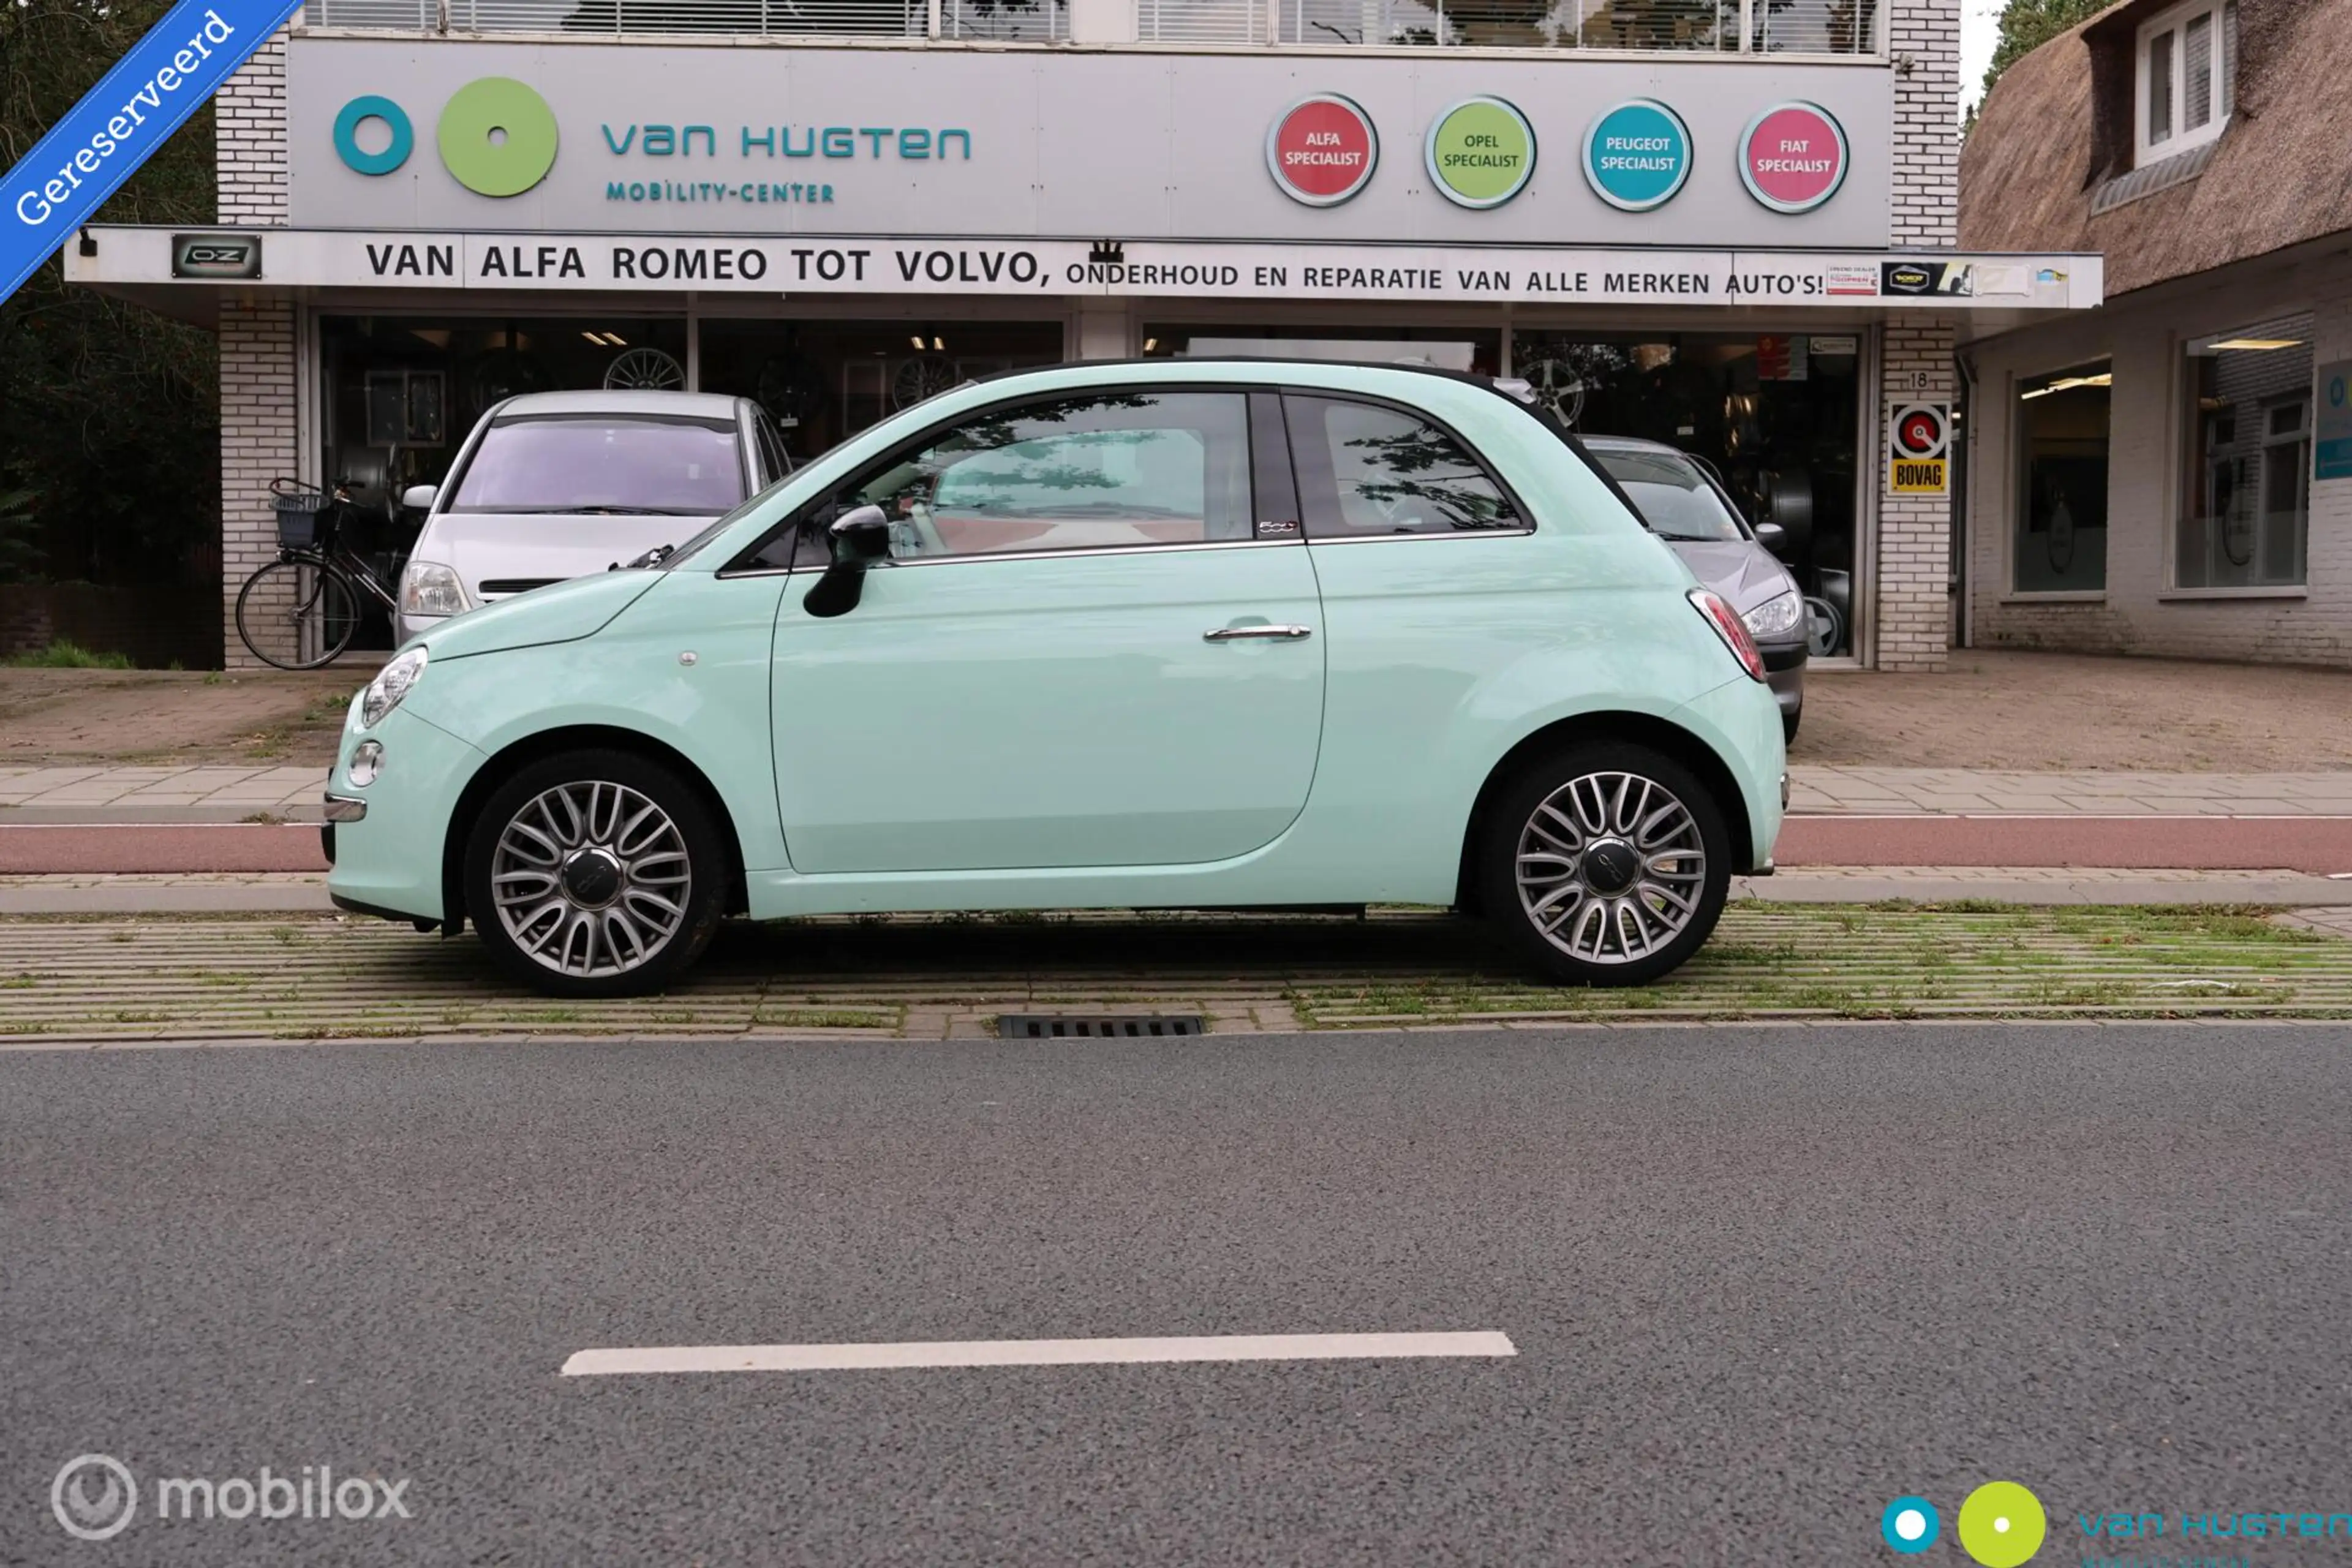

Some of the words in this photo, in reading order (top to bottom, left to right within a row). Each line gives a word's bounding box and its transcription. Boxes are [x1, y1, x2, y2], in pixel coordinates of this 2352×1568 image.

[1306, 133, 1341, 146] ALFA
[1464, 135, 1499, 148] OPEL
[1607, 137, 1670, 151] PEUGEOT
[1780, 140, 1809, 153] FIAT
[1286, 151, 1362, 166] SPECIALIST
[1444, 154, 1518, 168] SPECIALIST
[1600, 156, 1676, 171] SPECIALIST
[1757, 159, 1831, 173] SPECIALIST
[606, 181, 838, 203] MOBILITY-CENTER
[366, 244, 453, 276] VAN
[481, 246, 586, 278] ALFA
[614, 247, 767, 281] ROMEO
[791, 249, 871, 281] TOT
[895, 251, 1050, 287] VOLVO,
[1066, 263, 1238, 285] ONDERHOUD
[1256, 266, 1286, 287] EN
[1305, 267, 1442, 289] REPARATIE
[1458, 270, 1510, 290] VAN
[1527, 272, 1588, 292] ALLE
[1605, 273, 1709, 293] MERKEN
[1725, 274, 1823, 295] AUTO'S!
[1910, 372, 1928, 388] 18
[1896, 464, 1942, 486] BOVAG
